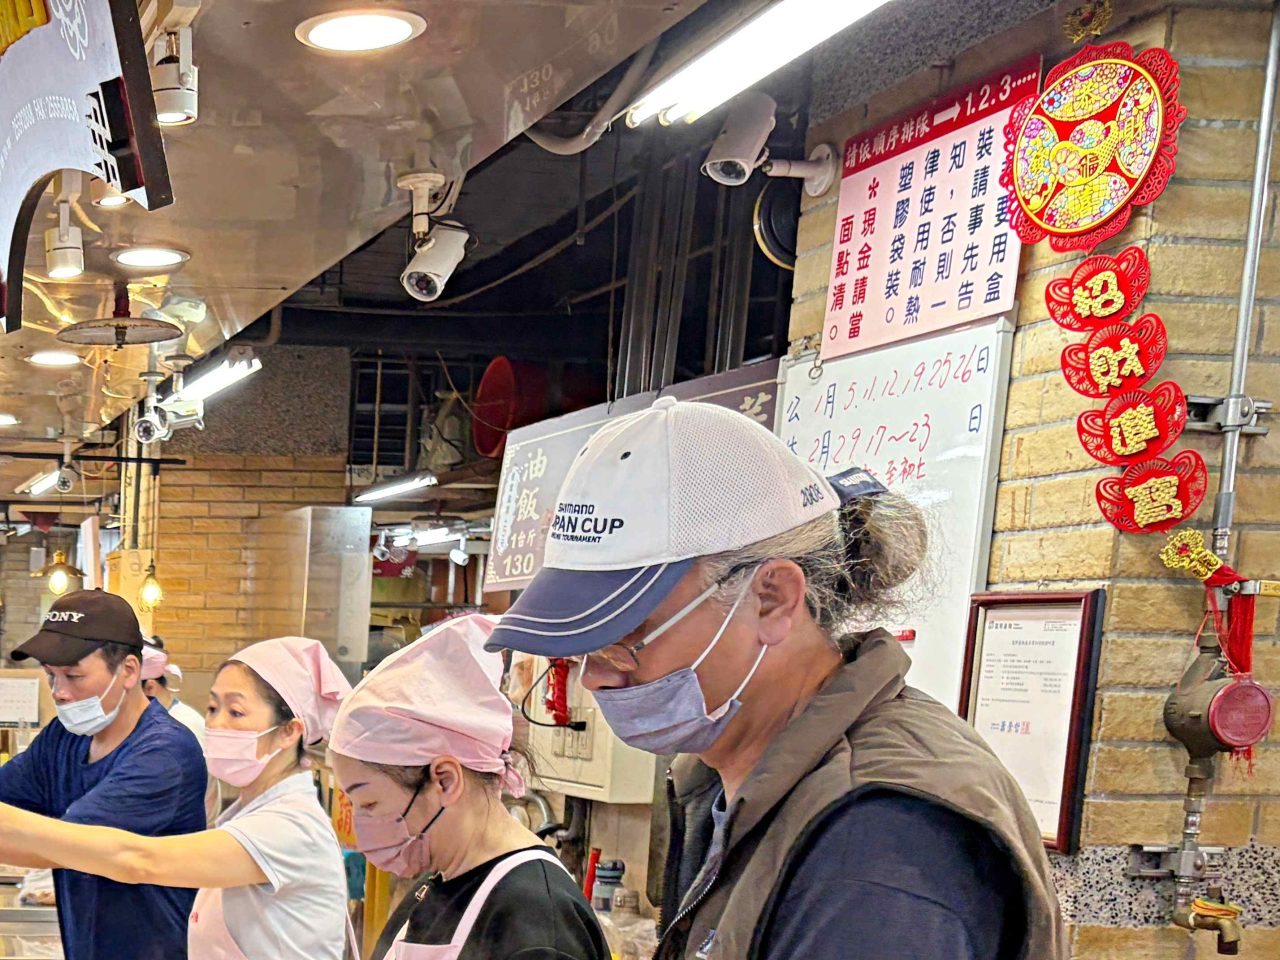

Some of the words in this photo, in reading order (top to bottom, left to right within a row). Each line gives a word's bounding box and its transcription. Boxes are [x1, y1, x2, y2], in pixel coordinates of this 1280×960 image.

[845, 112, 930, 168] 請依順序排隊
[904, 148, 941, 326] 律使用耐熱
[957, 127, 995, 311] 裝請事先告
[983, 160, 1010, 305] 要用盒
[503, 553, 535, 577] 130
[581, 517, 625, 534] CUP
